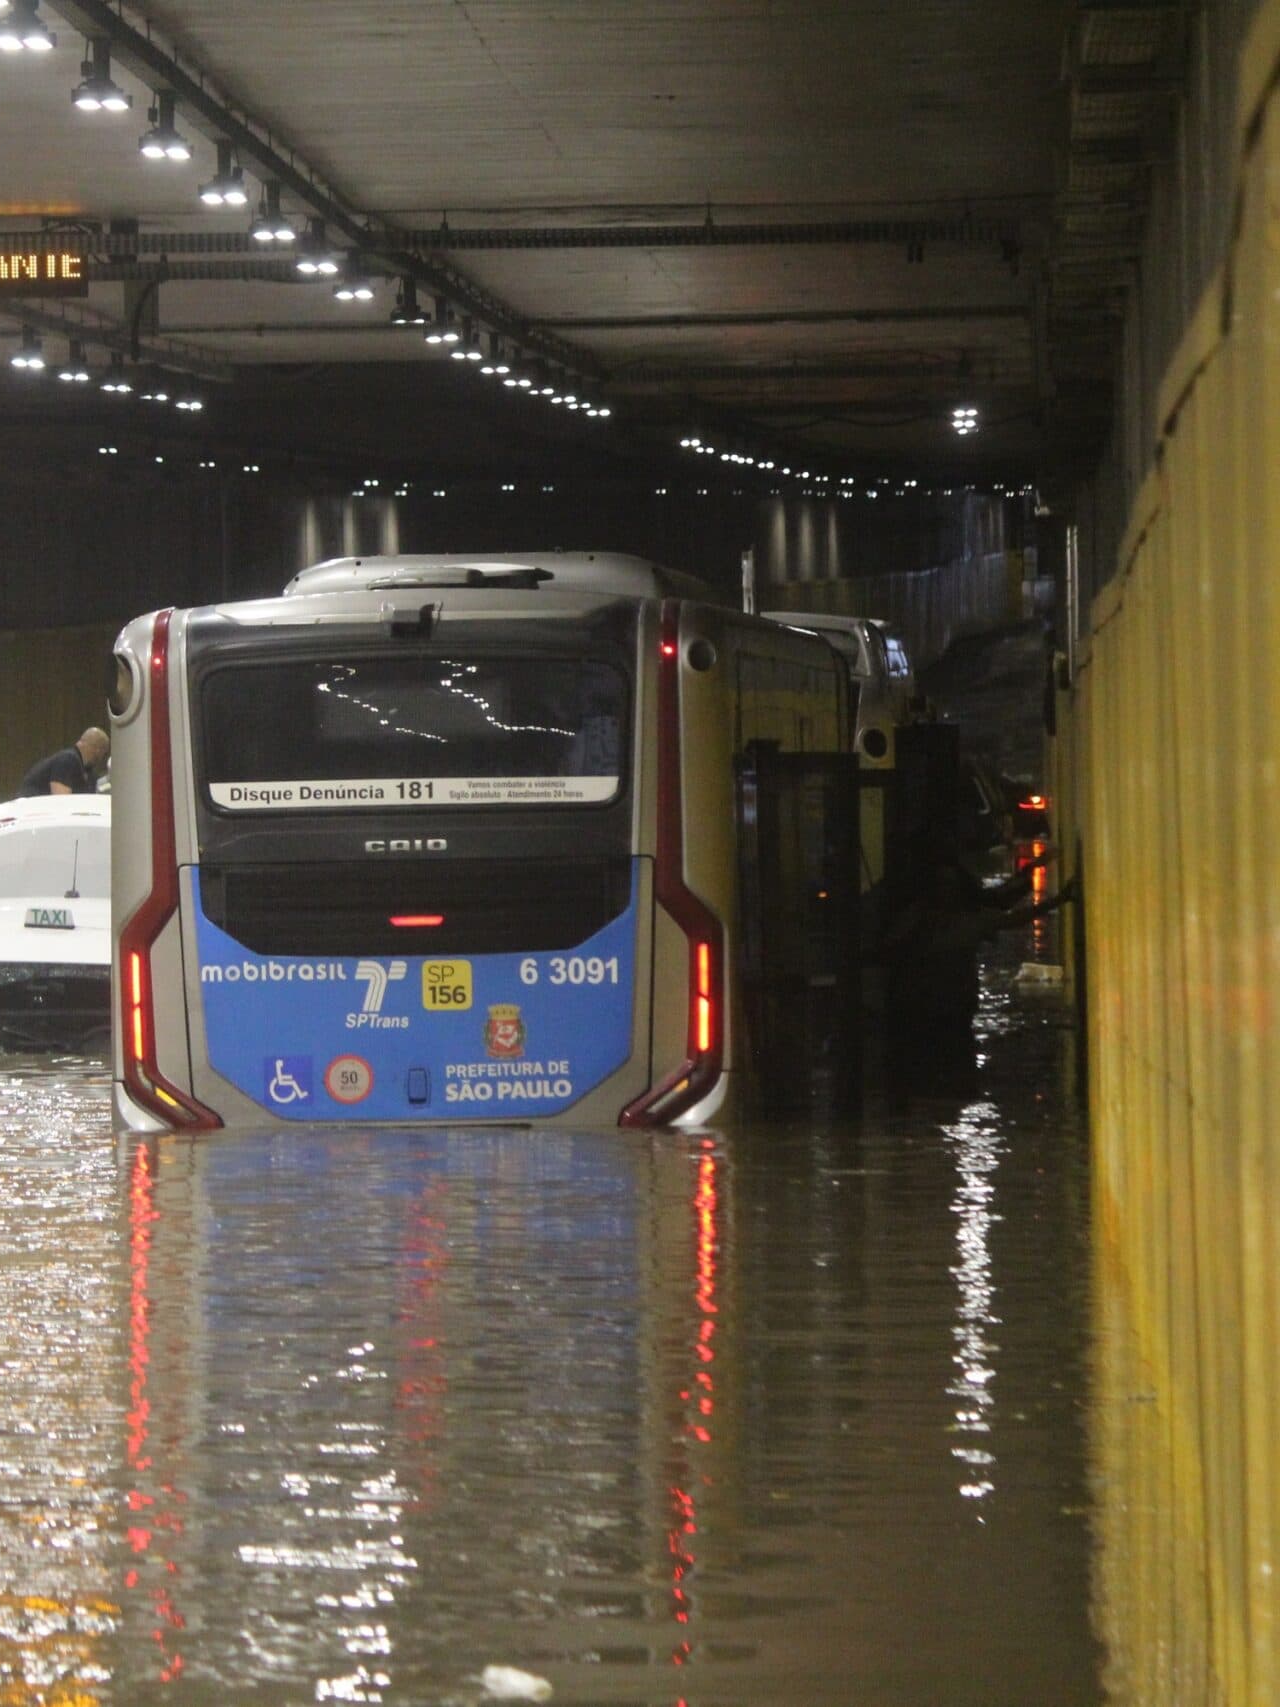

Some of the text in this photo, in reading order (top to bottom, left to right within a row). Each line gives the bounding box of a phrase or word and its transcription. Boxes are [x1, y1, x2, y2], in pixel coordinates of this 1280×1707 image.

[230, 781, 434, 804] Disque Denúncia 181
[493, 780, 526, 788] combater
[449, 790, 469, 800] Sigilo
[471, 790, 501, 799] absoluto
[507, 789, 552, 798] Atendimento
[553, 790, 561, 798] 24
[563, 789, 584, 798] horas
[31, 909, 66, 925] TAXI
[201, 961, 347, 982] mobibrasil
[428, 965, 455, 983] SP
[520, 957, 618, 984] 6 3091
[428, 985, 466, 1004] 156
[345, 1013, 409, 1028] SPTrans
[341, 1071, 358, 1084] 50
[446, 1061, 569, 1078] PREFEITURA DE
[446, 1080, 572, 1101] SÃO PAULO
